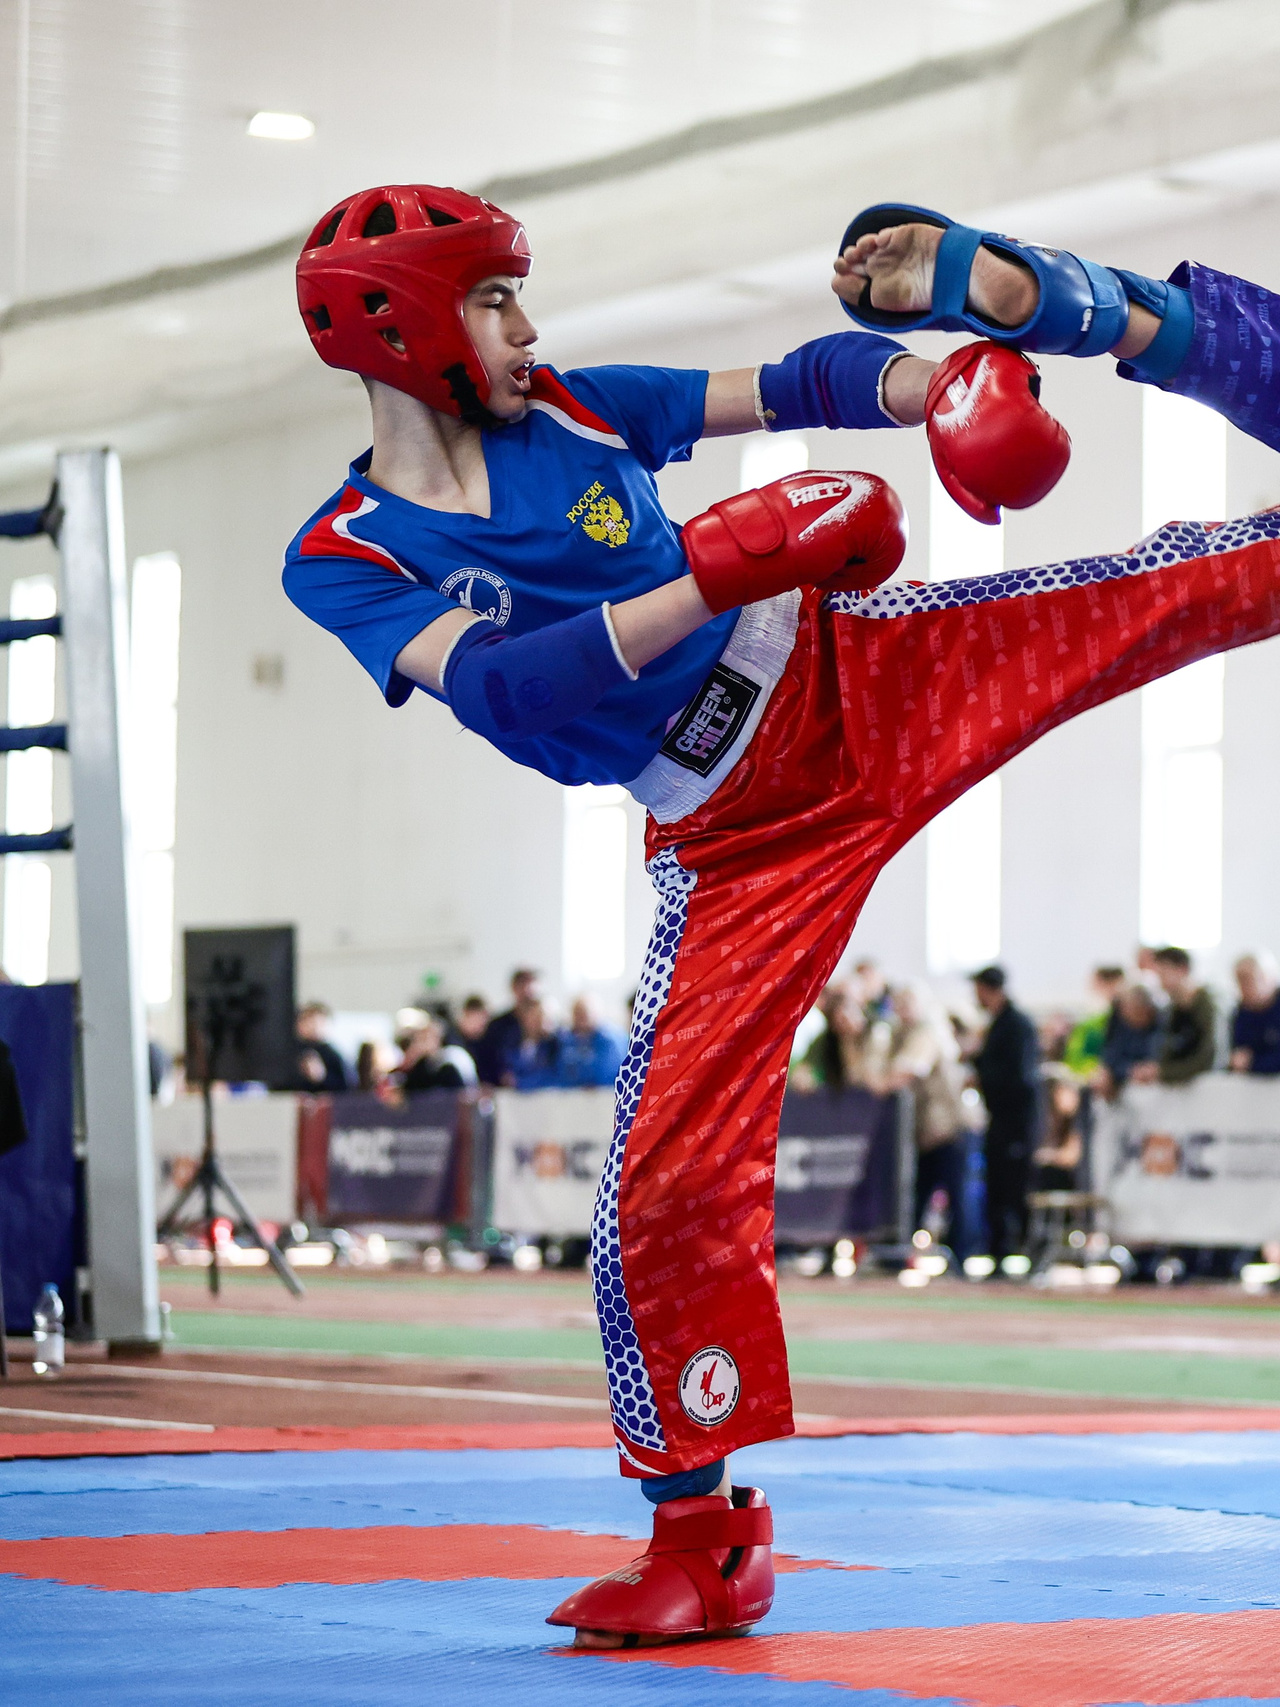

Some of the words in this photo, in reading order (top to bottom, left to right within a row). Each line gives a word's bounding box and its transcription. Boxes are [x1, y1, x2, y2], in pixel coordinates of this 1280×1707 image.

[565, 480, 605, 524] РОССИЯ
[675, 682, 726, 752] GREEN
[690, 707, 738, 759] HILL
